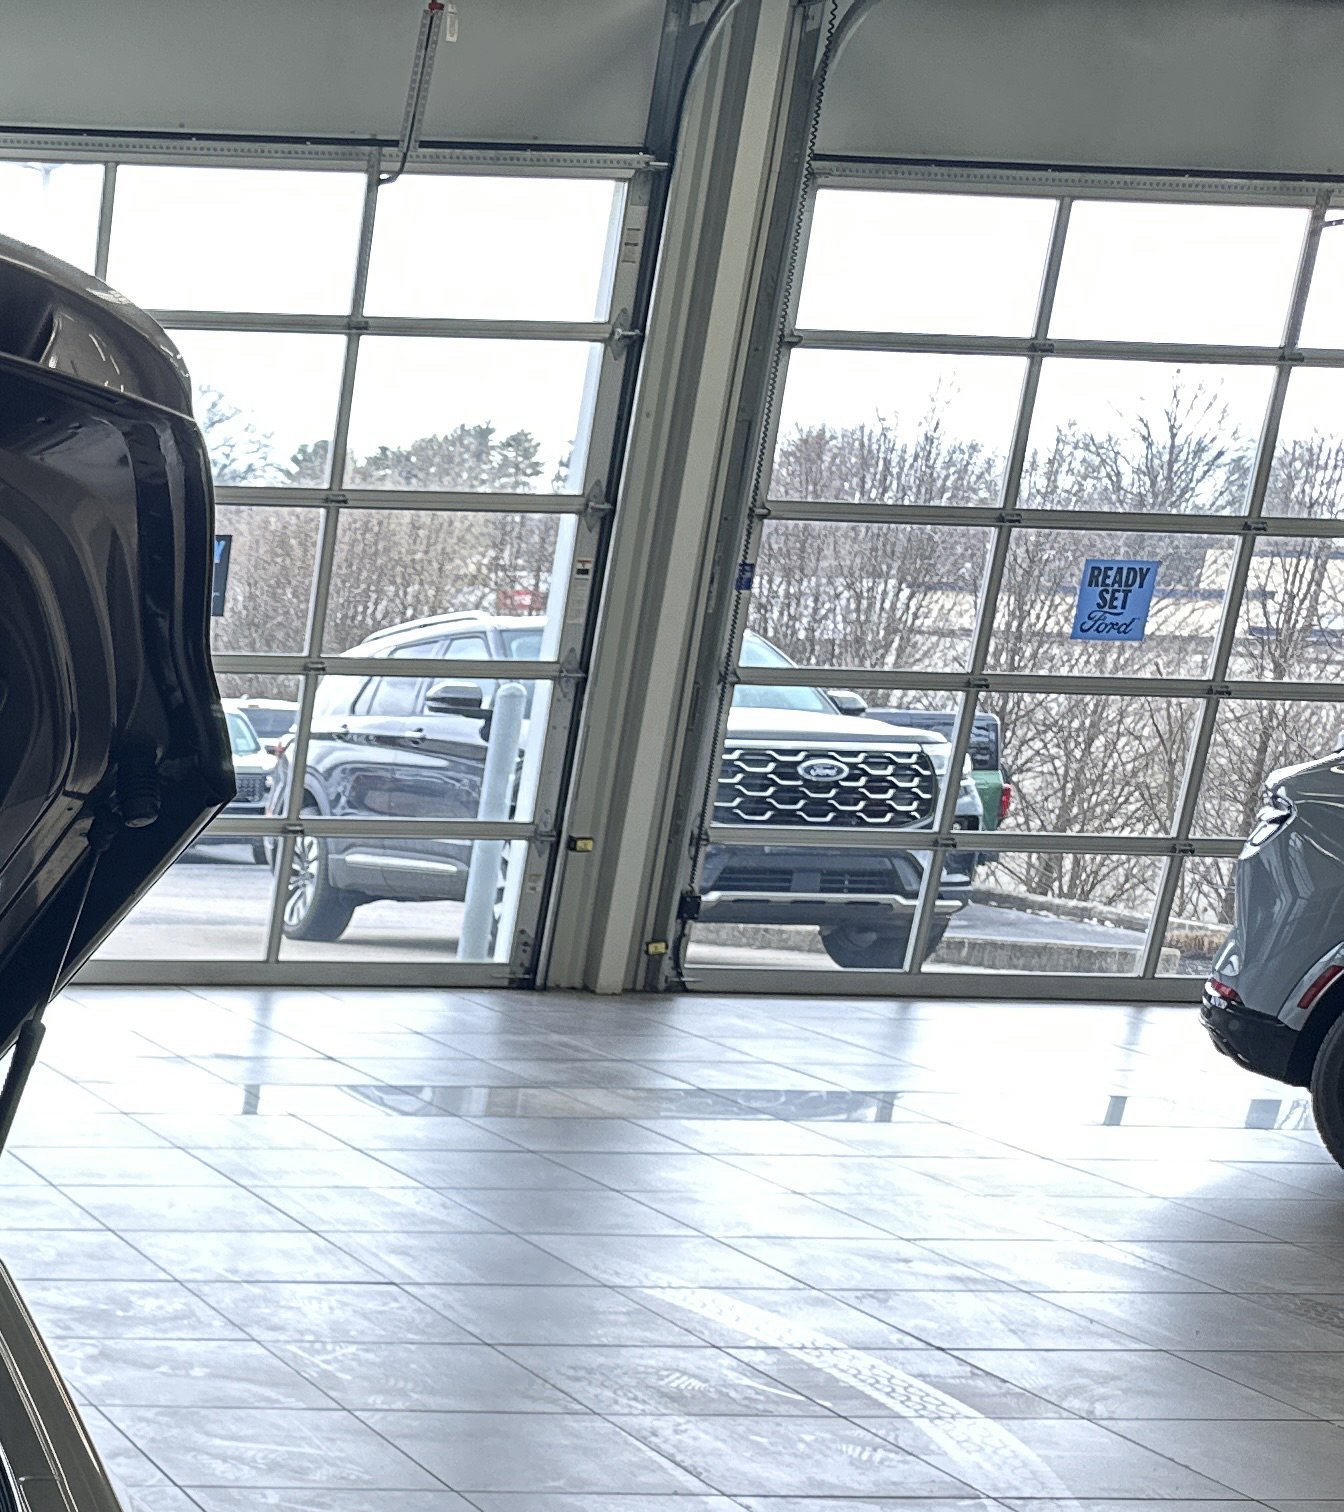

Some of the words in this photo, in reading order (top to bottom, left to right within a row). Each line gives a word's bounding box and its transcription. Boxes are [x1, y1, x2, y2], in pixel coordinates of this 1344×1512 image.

[1087, 566, 1151, 589] READY
[1096, 589, 1132, 610] SET
[1080, 609, 1135, 635] Ford
